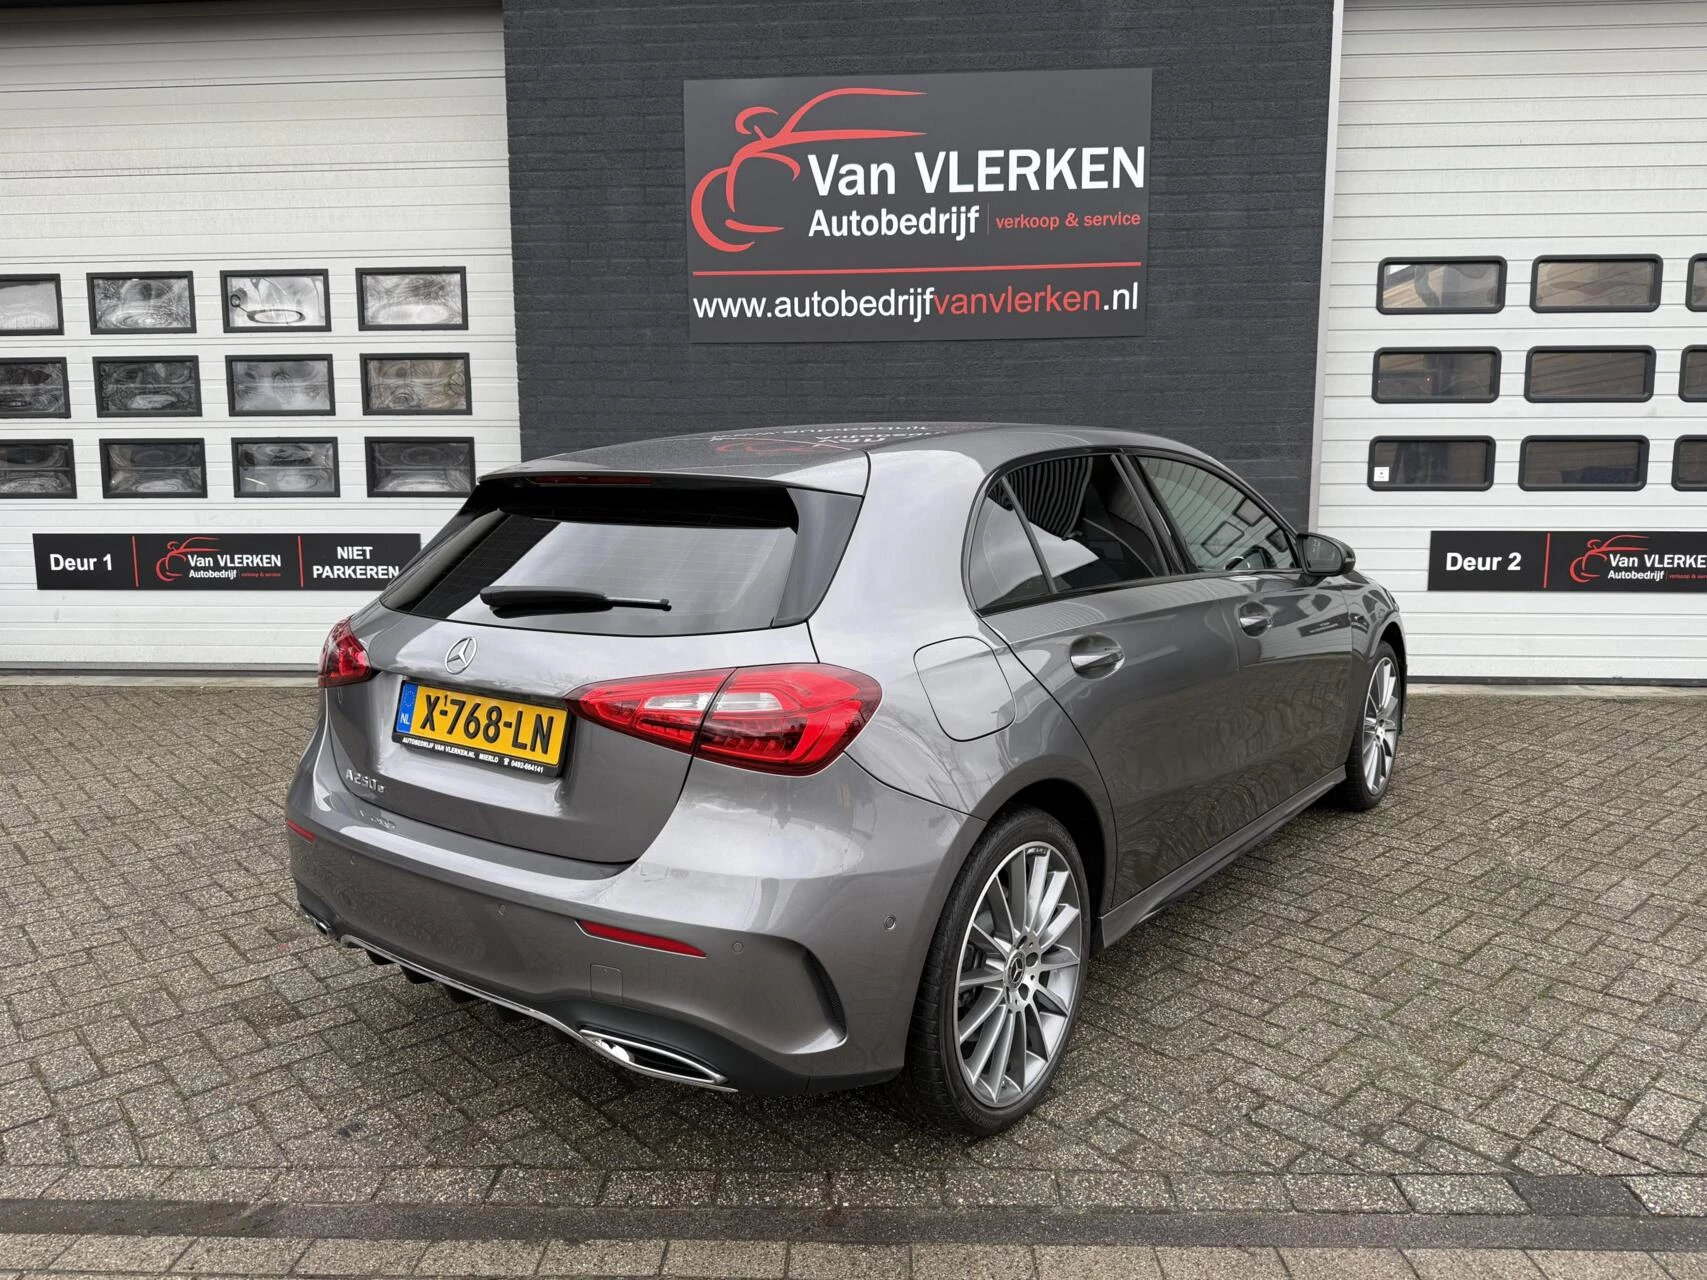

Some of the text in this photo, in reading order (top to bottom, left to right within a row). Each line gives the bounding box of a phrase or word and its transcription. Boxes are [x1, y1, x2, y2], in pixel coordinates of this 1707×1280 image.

[807, 146, 1145, 196] Van VLERKEN
[808, 205, 1141, 241] Autobedrijf verkoop & service
[693, 282, 1138, 322] www.autobedrijfvanvlerken.nl
[337, 546, 373, 559] NIET
[49, 553, 112, 571] Deur 1
[187, 554, 281, 567] Van VLERKEN
[1446, 552, 1522, 571] Deur 2
[1609, 554, 1638, 567] Van
[189, 569, 237, 580] Autobedrijf
[312, 565, 399, 578] PARKEREN
[1607, 570, 1665, 581] Autobedrijf
[400, 712, 411, 725] NL
[420, 694, 555, 755] X-768-LN
[402, 737, 434, 749] AUTOBEDRIJF
[434, 744, 445, 752] VAN
[479, 753, 499, 764] MIERLO
